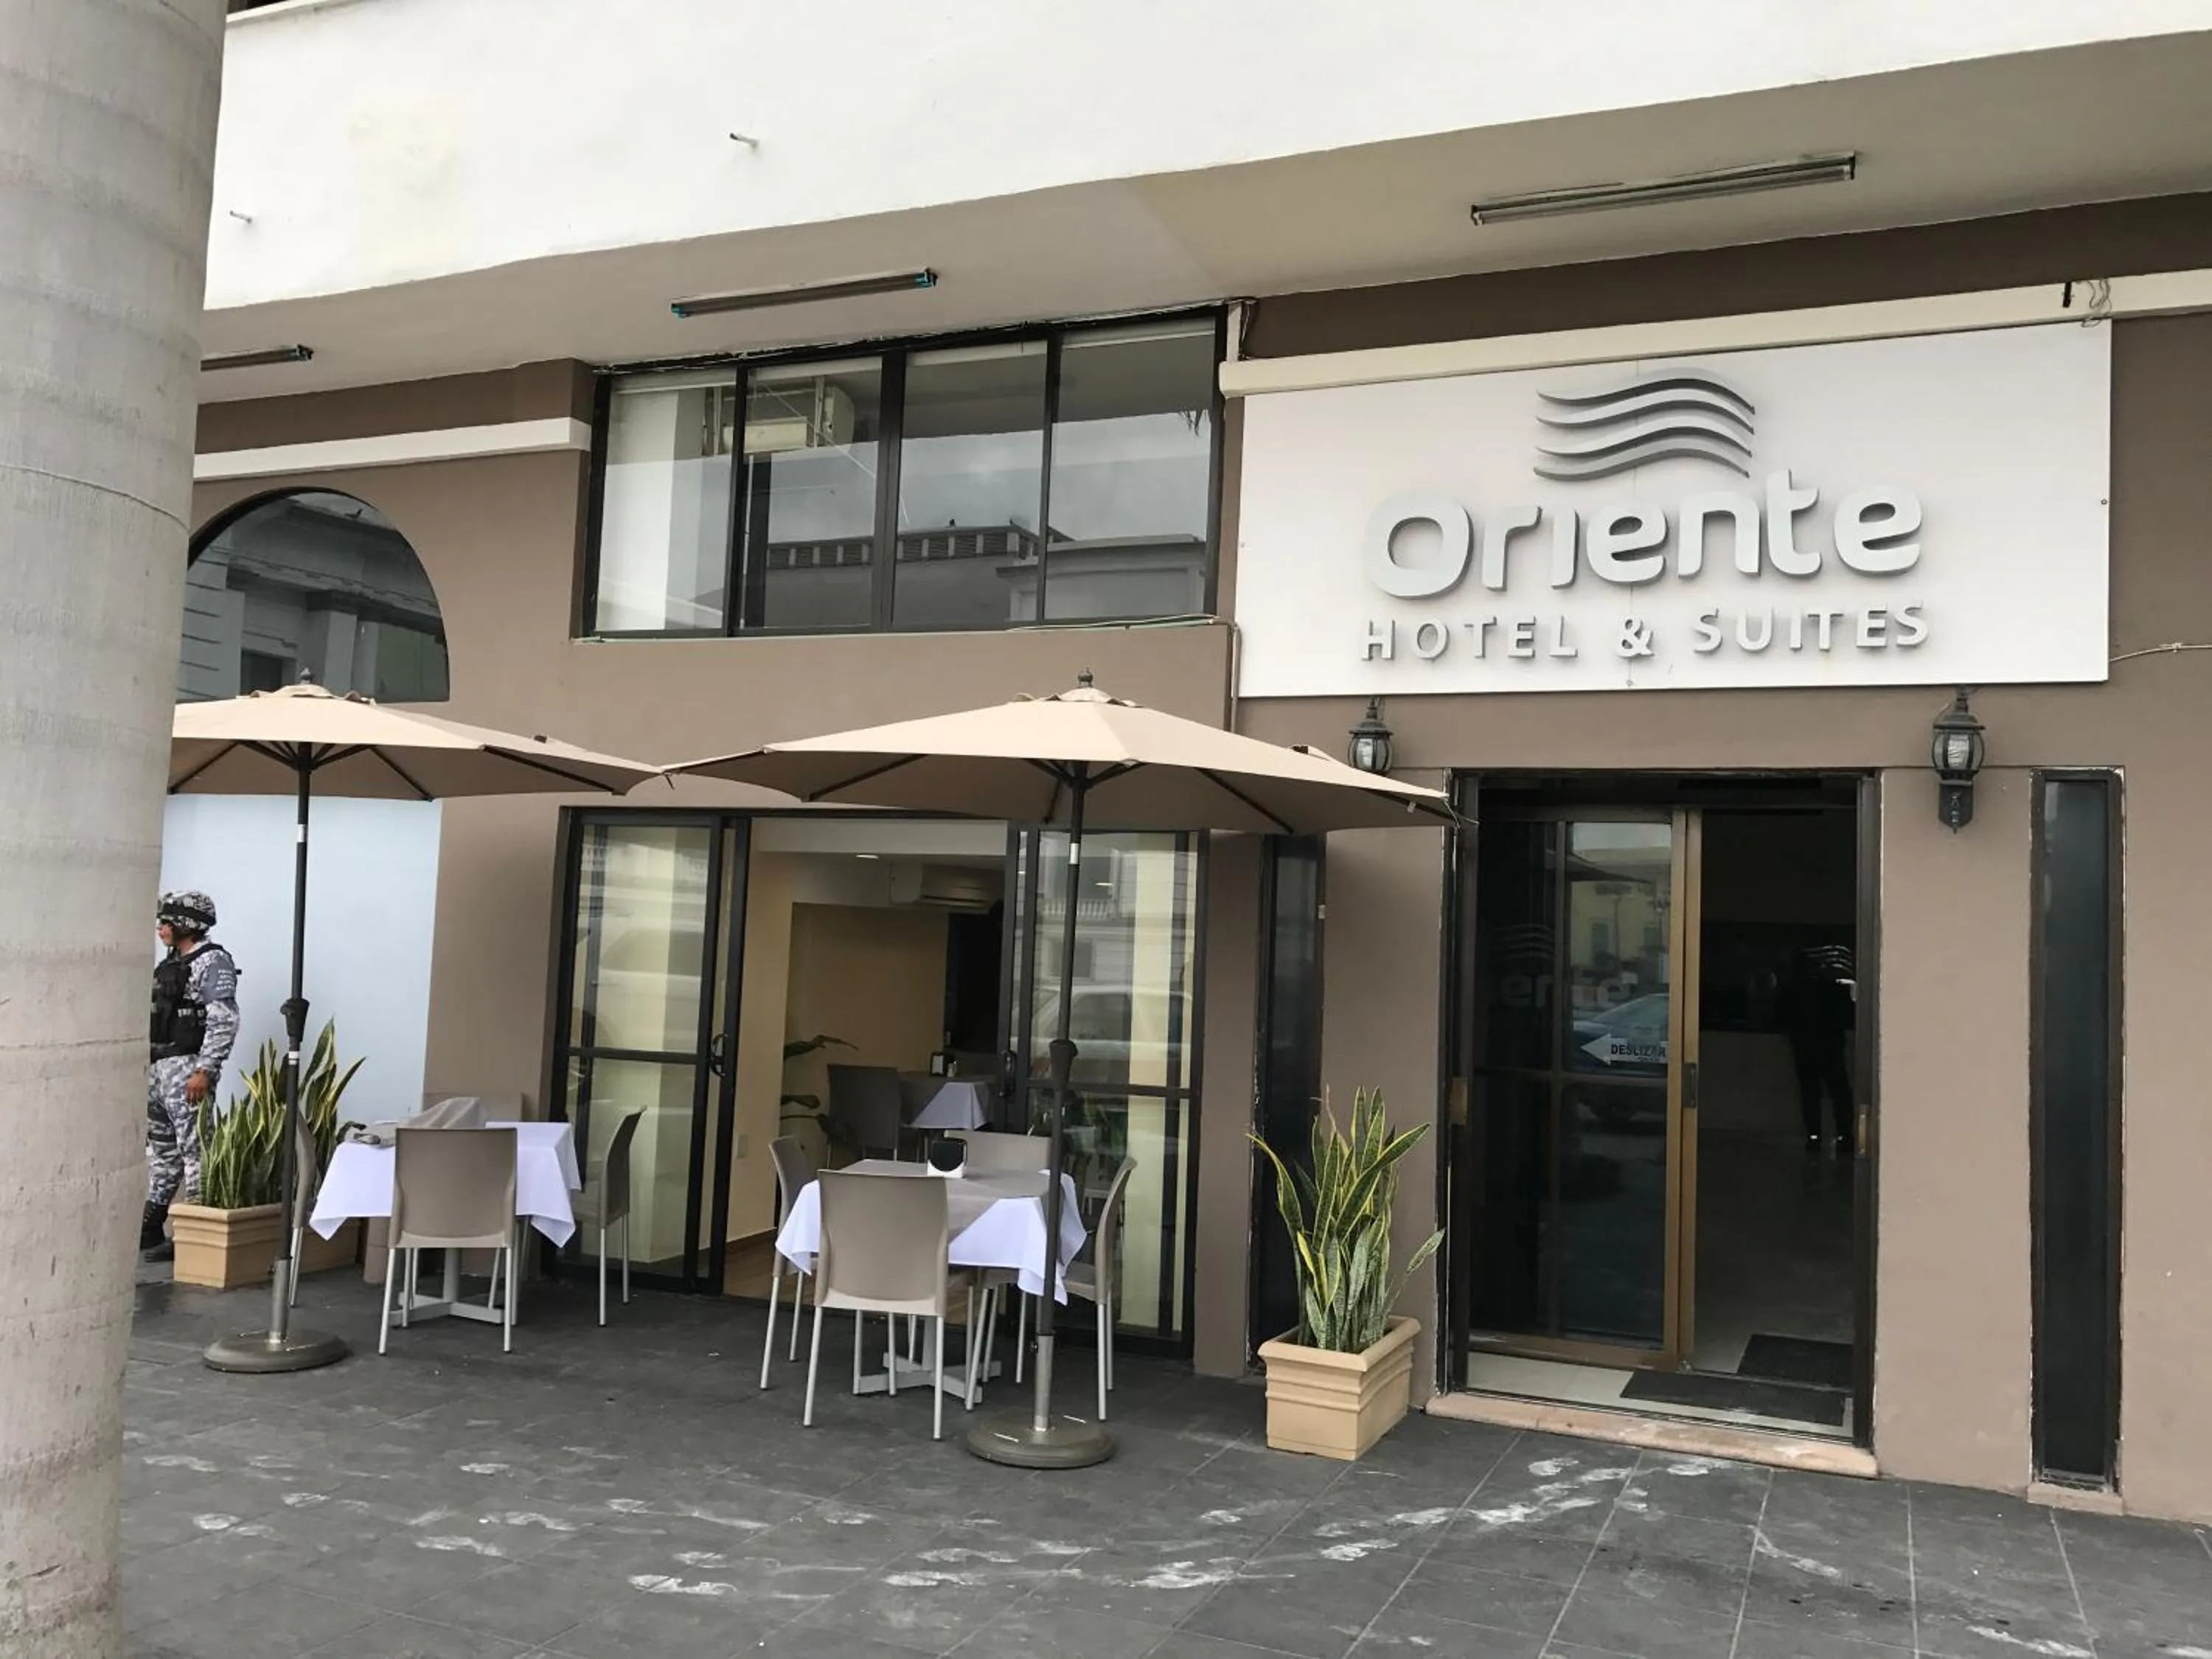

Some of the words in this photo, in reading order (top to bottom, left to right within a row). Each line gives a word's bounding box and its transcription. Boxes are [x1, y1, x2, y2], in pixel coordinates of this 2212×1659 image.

[1360, 616, 1578, 662] HOTEL
[1615, 616, 1655, 658] &
[1691, 599, 1930, 653] SUITES
